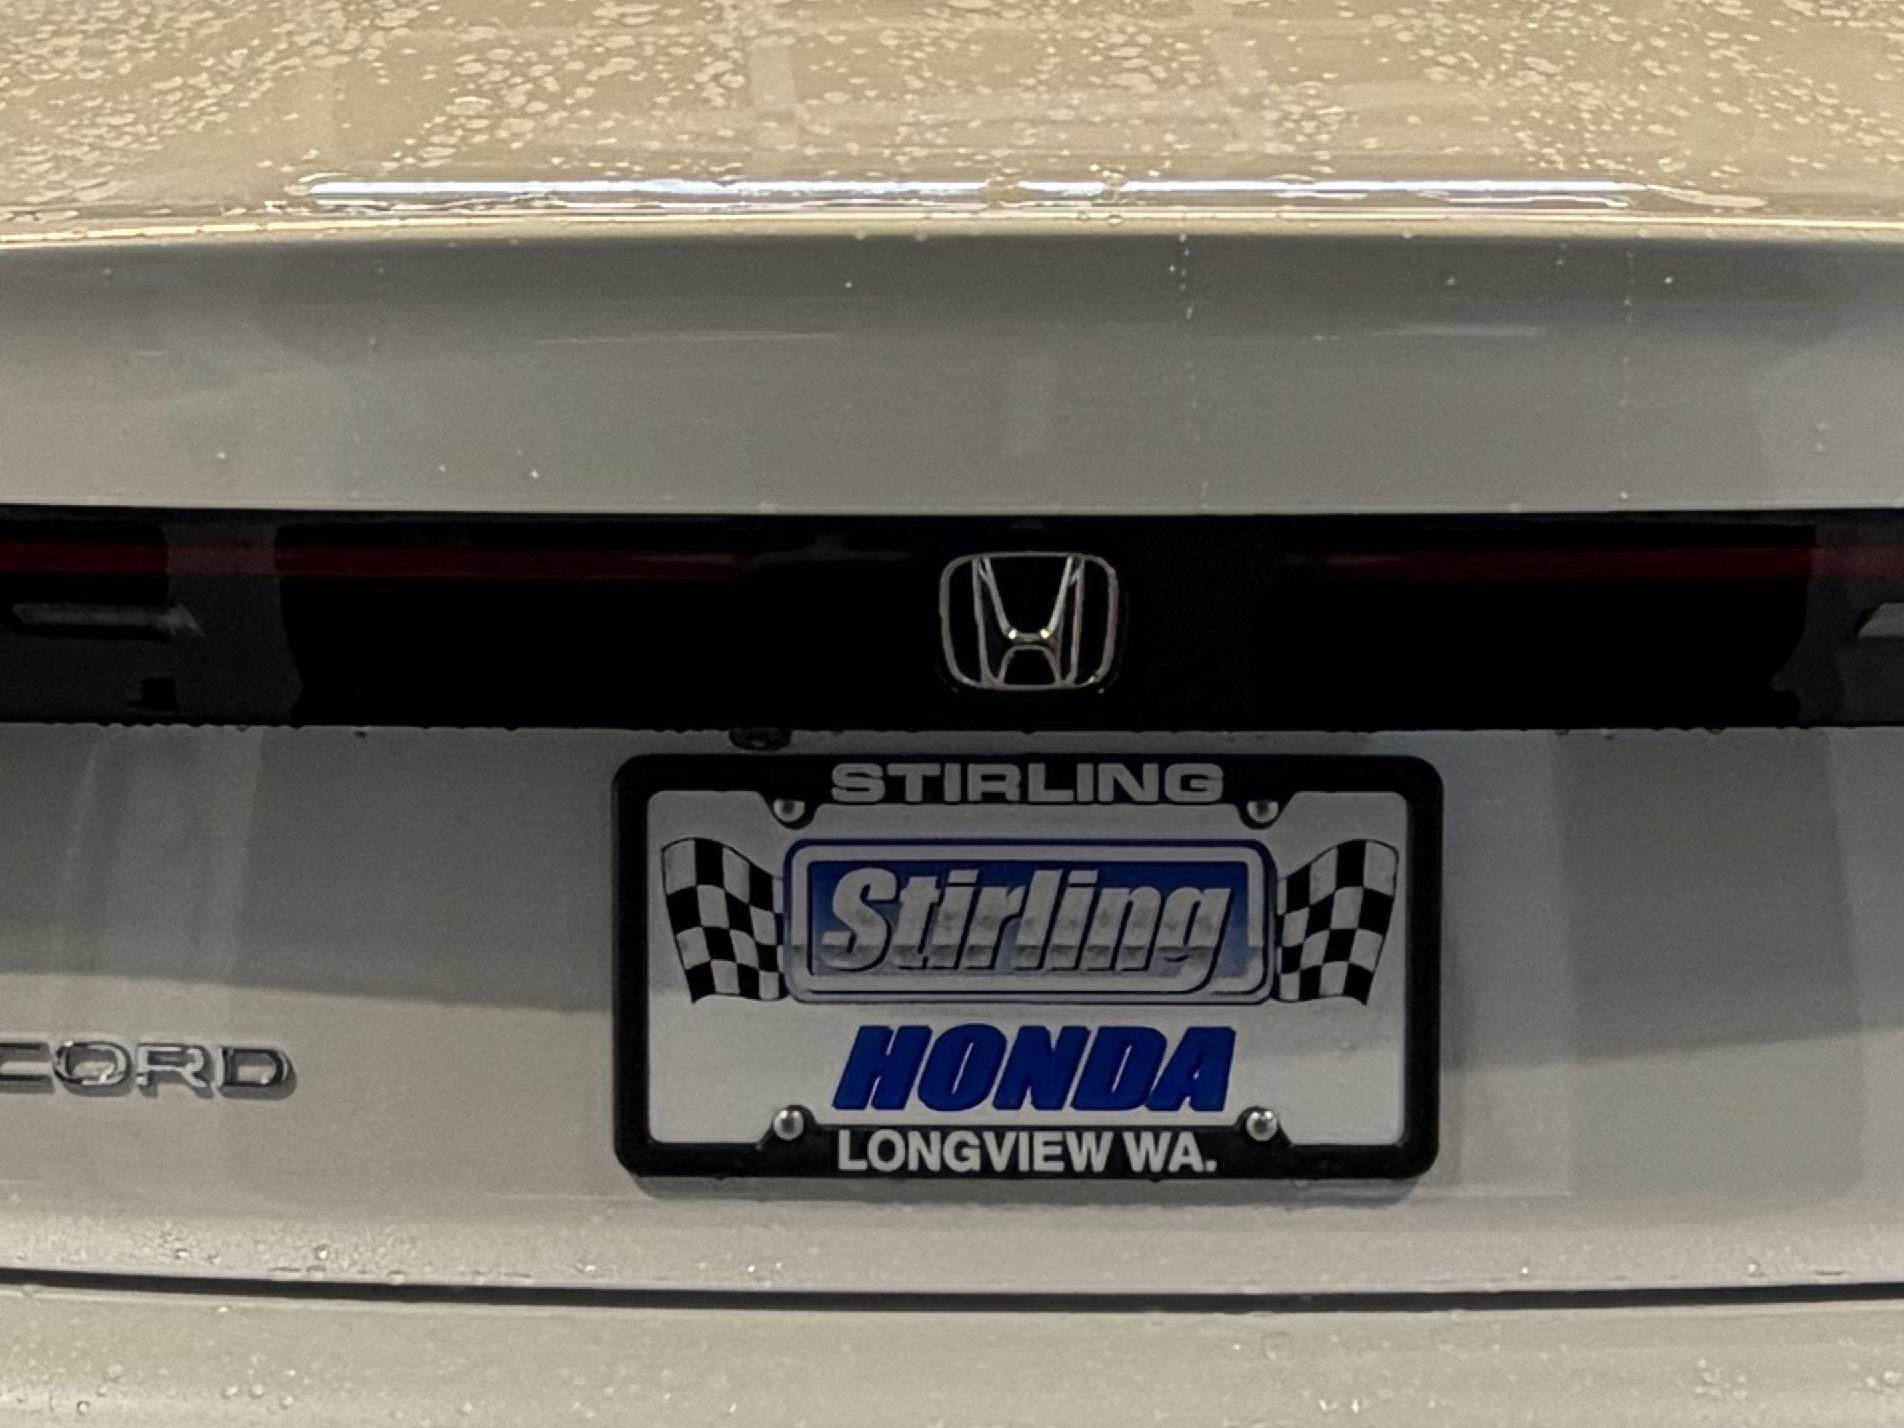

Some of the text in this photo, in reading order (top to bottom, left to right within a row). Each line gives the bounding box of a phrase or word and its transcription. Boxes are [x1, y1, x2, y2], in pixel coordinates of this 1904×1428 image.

[831, 762, 1224, 803] STIRLING
[820, 866, 1232, 994] Stirling
[832, 1022, 1237, 1112] HONDA
[837, 1129, 1218, 1173] LONGVIEW WA.
